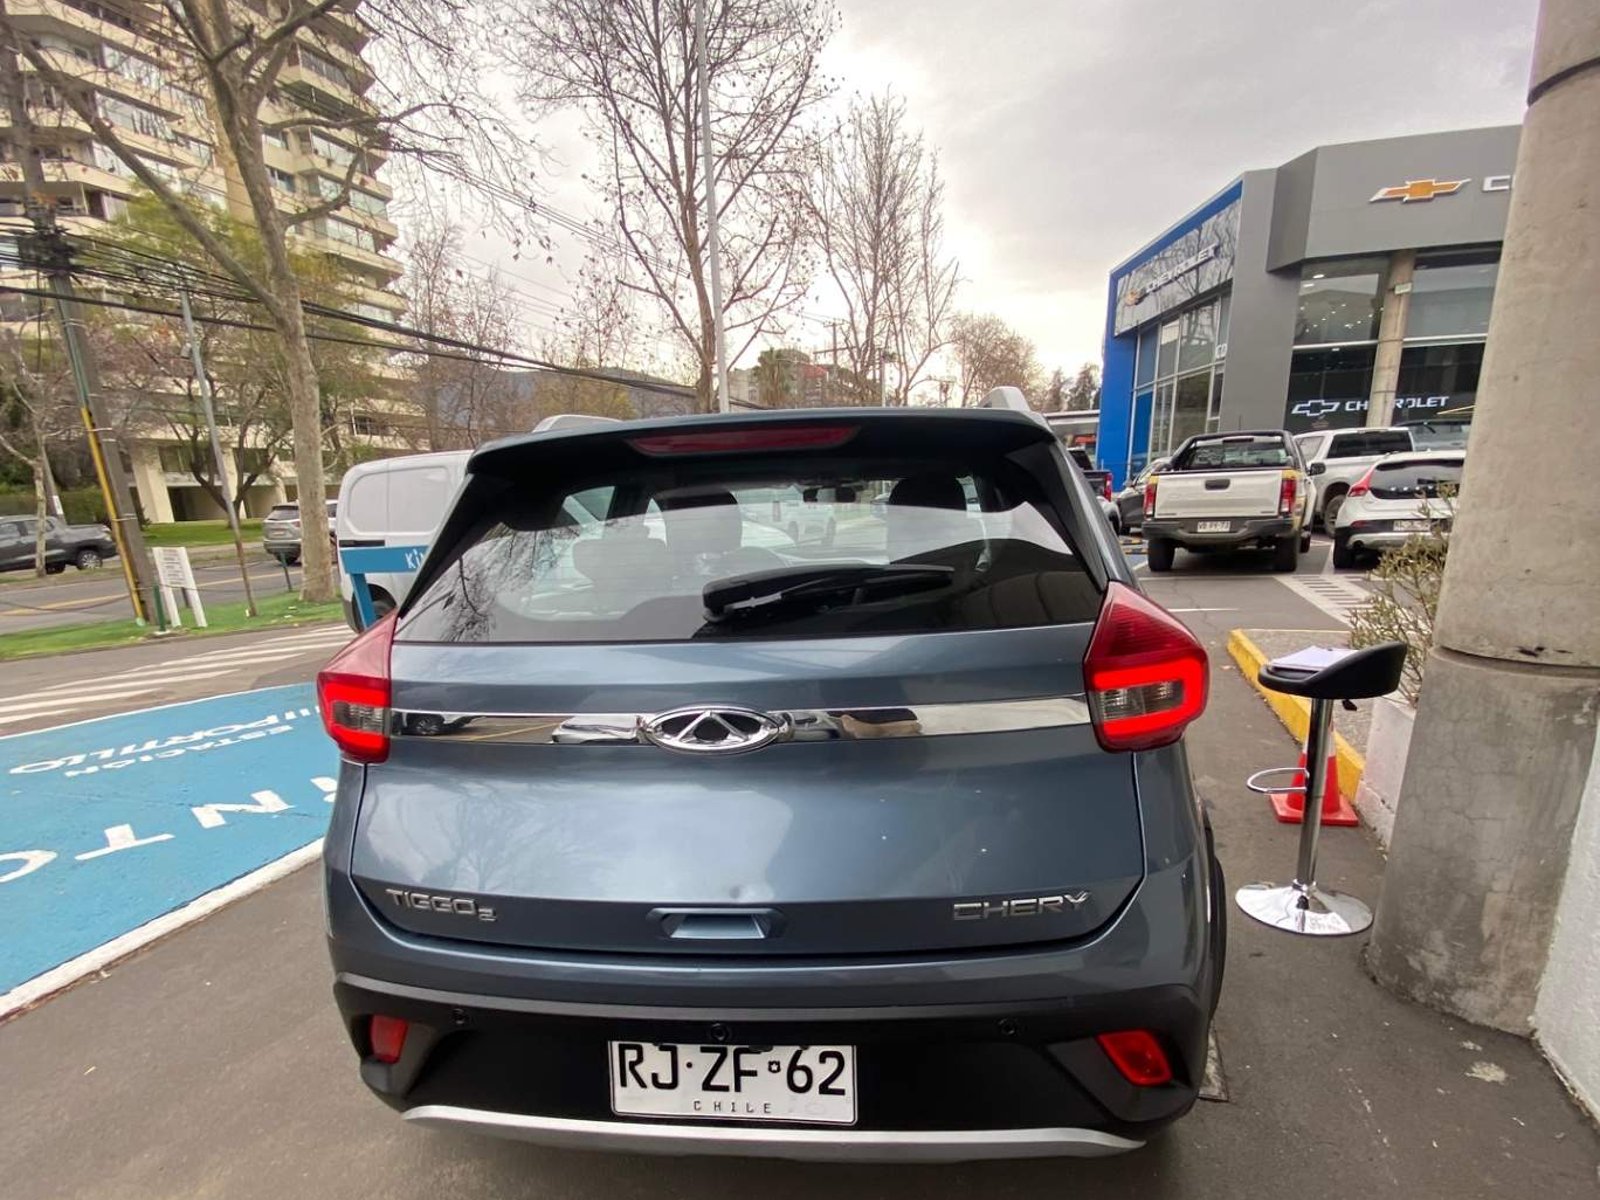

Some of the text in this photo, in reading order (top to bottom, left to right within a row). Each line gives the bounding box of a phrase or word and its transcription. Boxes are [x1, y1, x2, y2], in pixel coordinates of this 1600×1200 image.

[1345, 396, 1450, 412] CHROLET
[953, 890, 1091, 921] CHERY
[693, 1100, 772, 1114] CHILE
